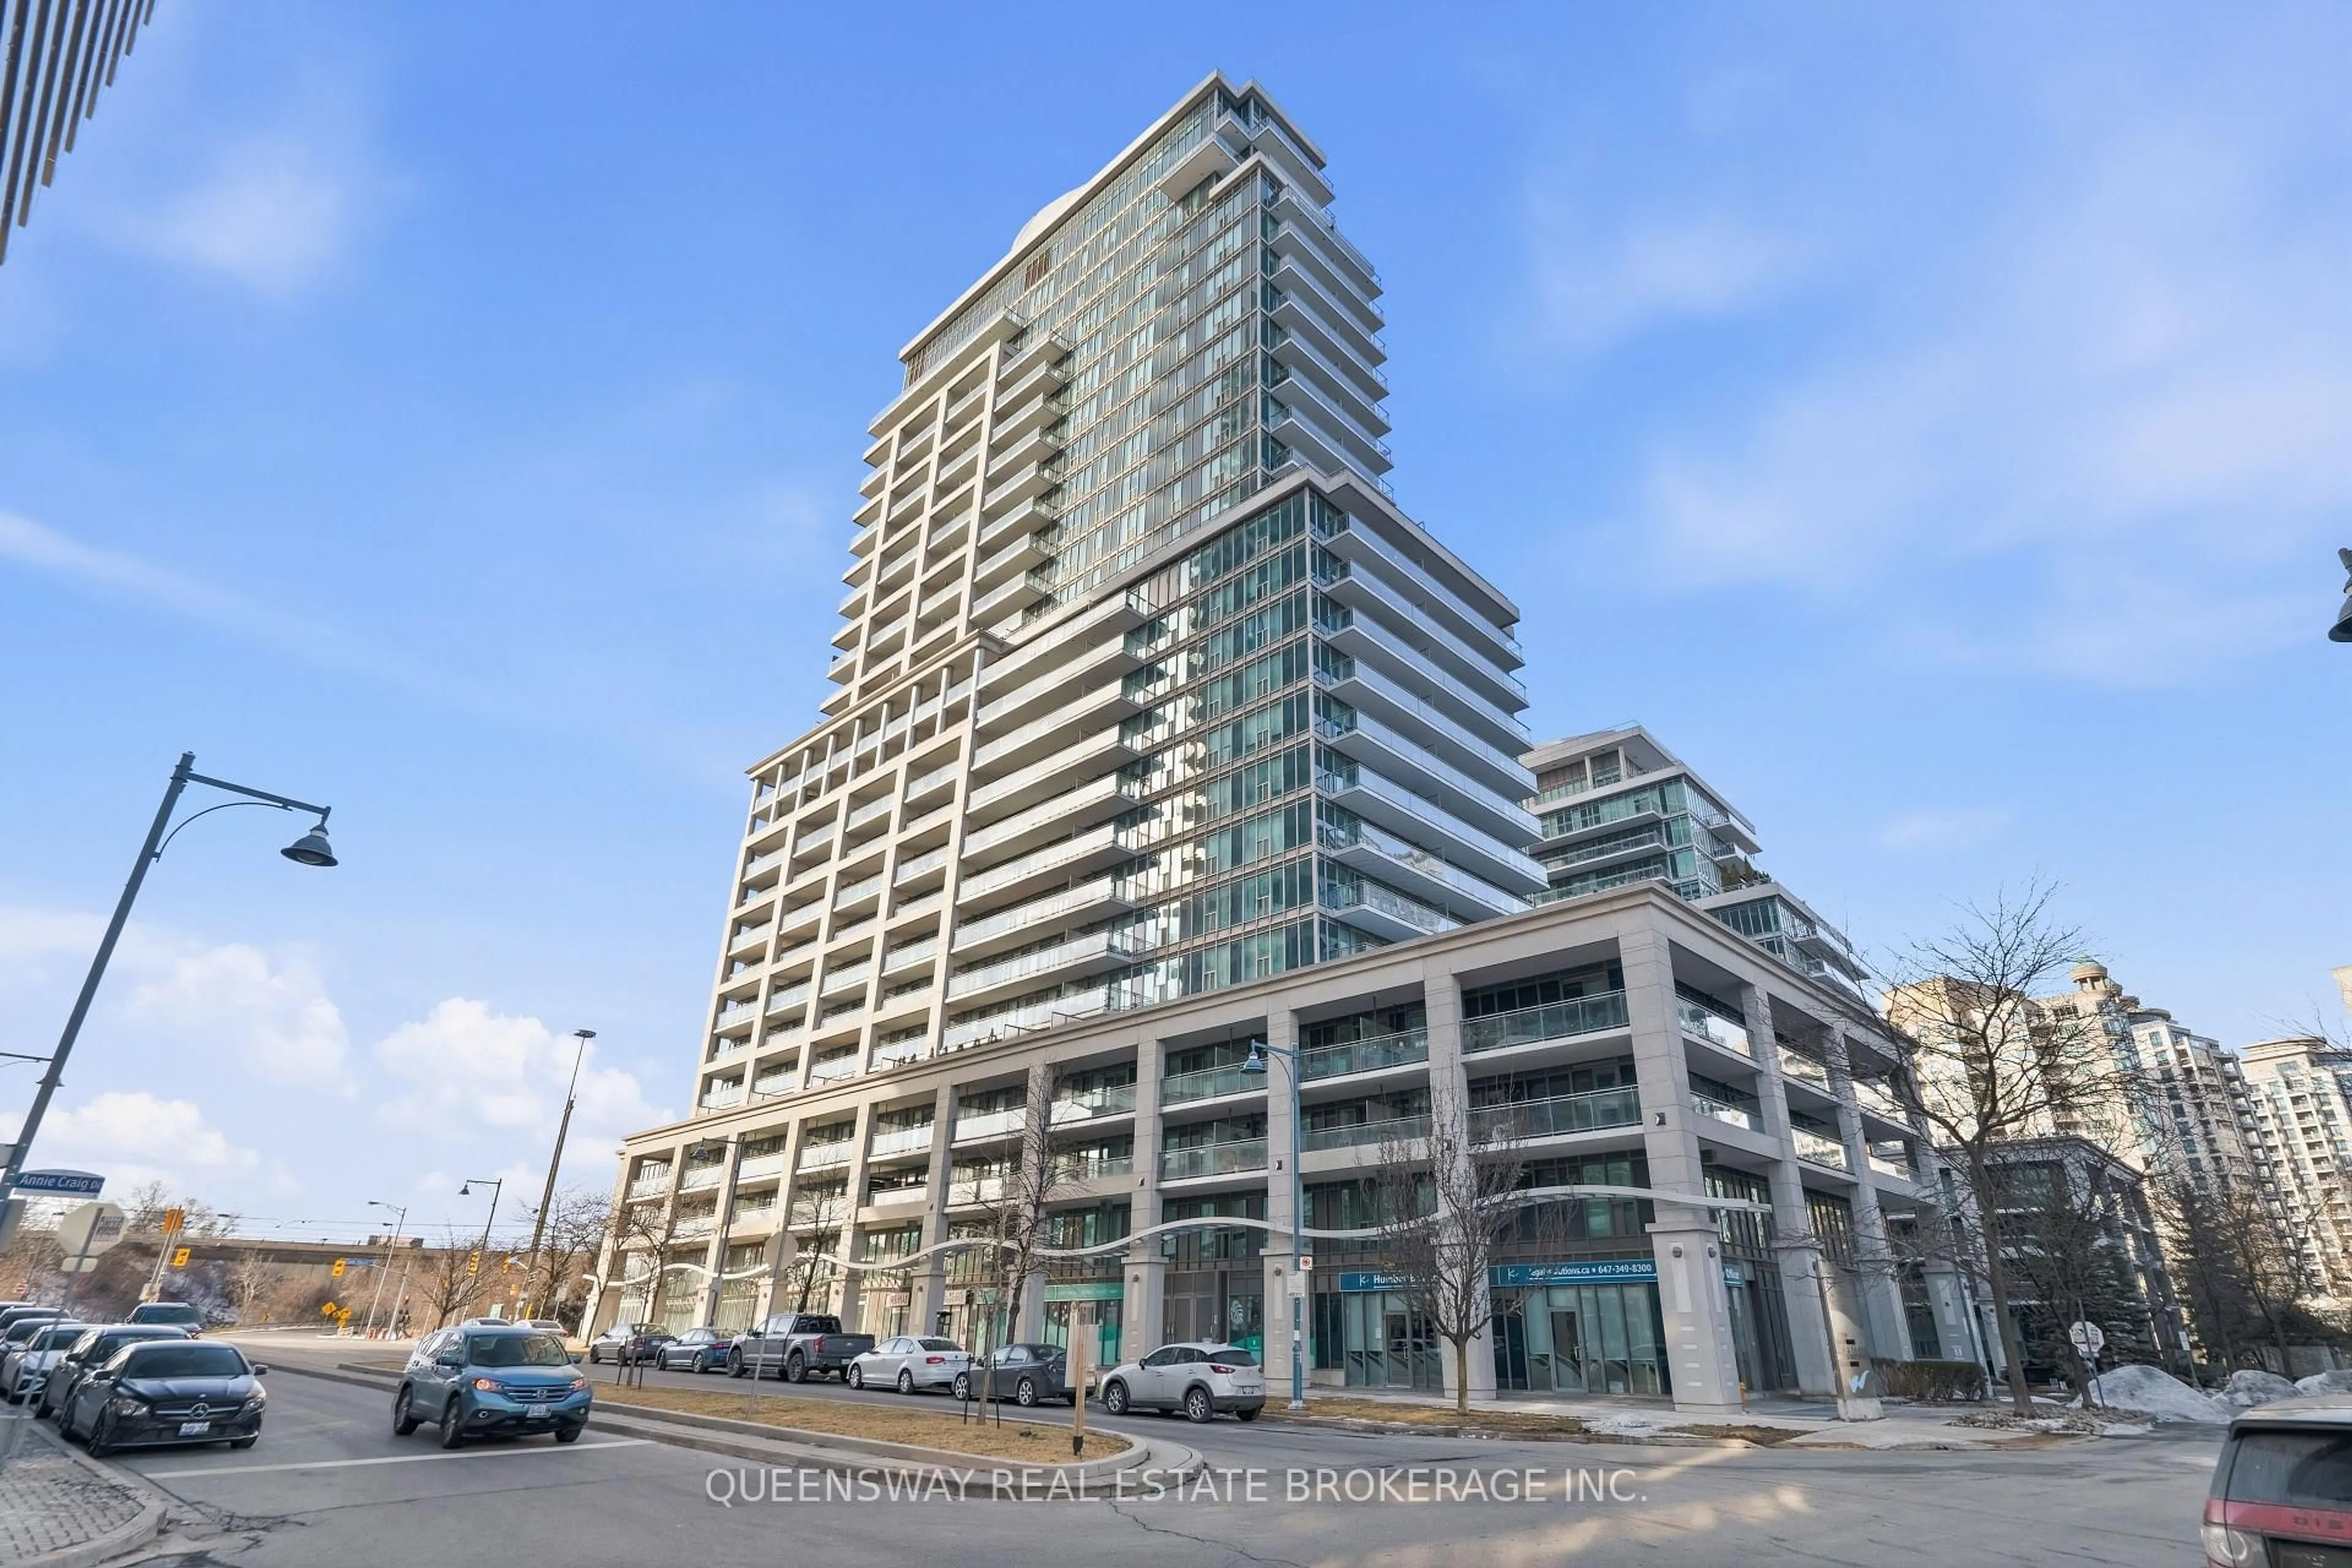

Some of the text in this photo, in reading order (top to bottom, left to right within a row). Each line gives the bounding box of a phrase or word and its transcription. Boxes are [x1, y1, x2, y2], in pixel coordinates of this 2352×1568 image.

[20, 1174, 55, 1187] Annie
[57, 1176, 88, 1191] Craig
[1598, 1264, 1652, 1274] 647-349-8300
